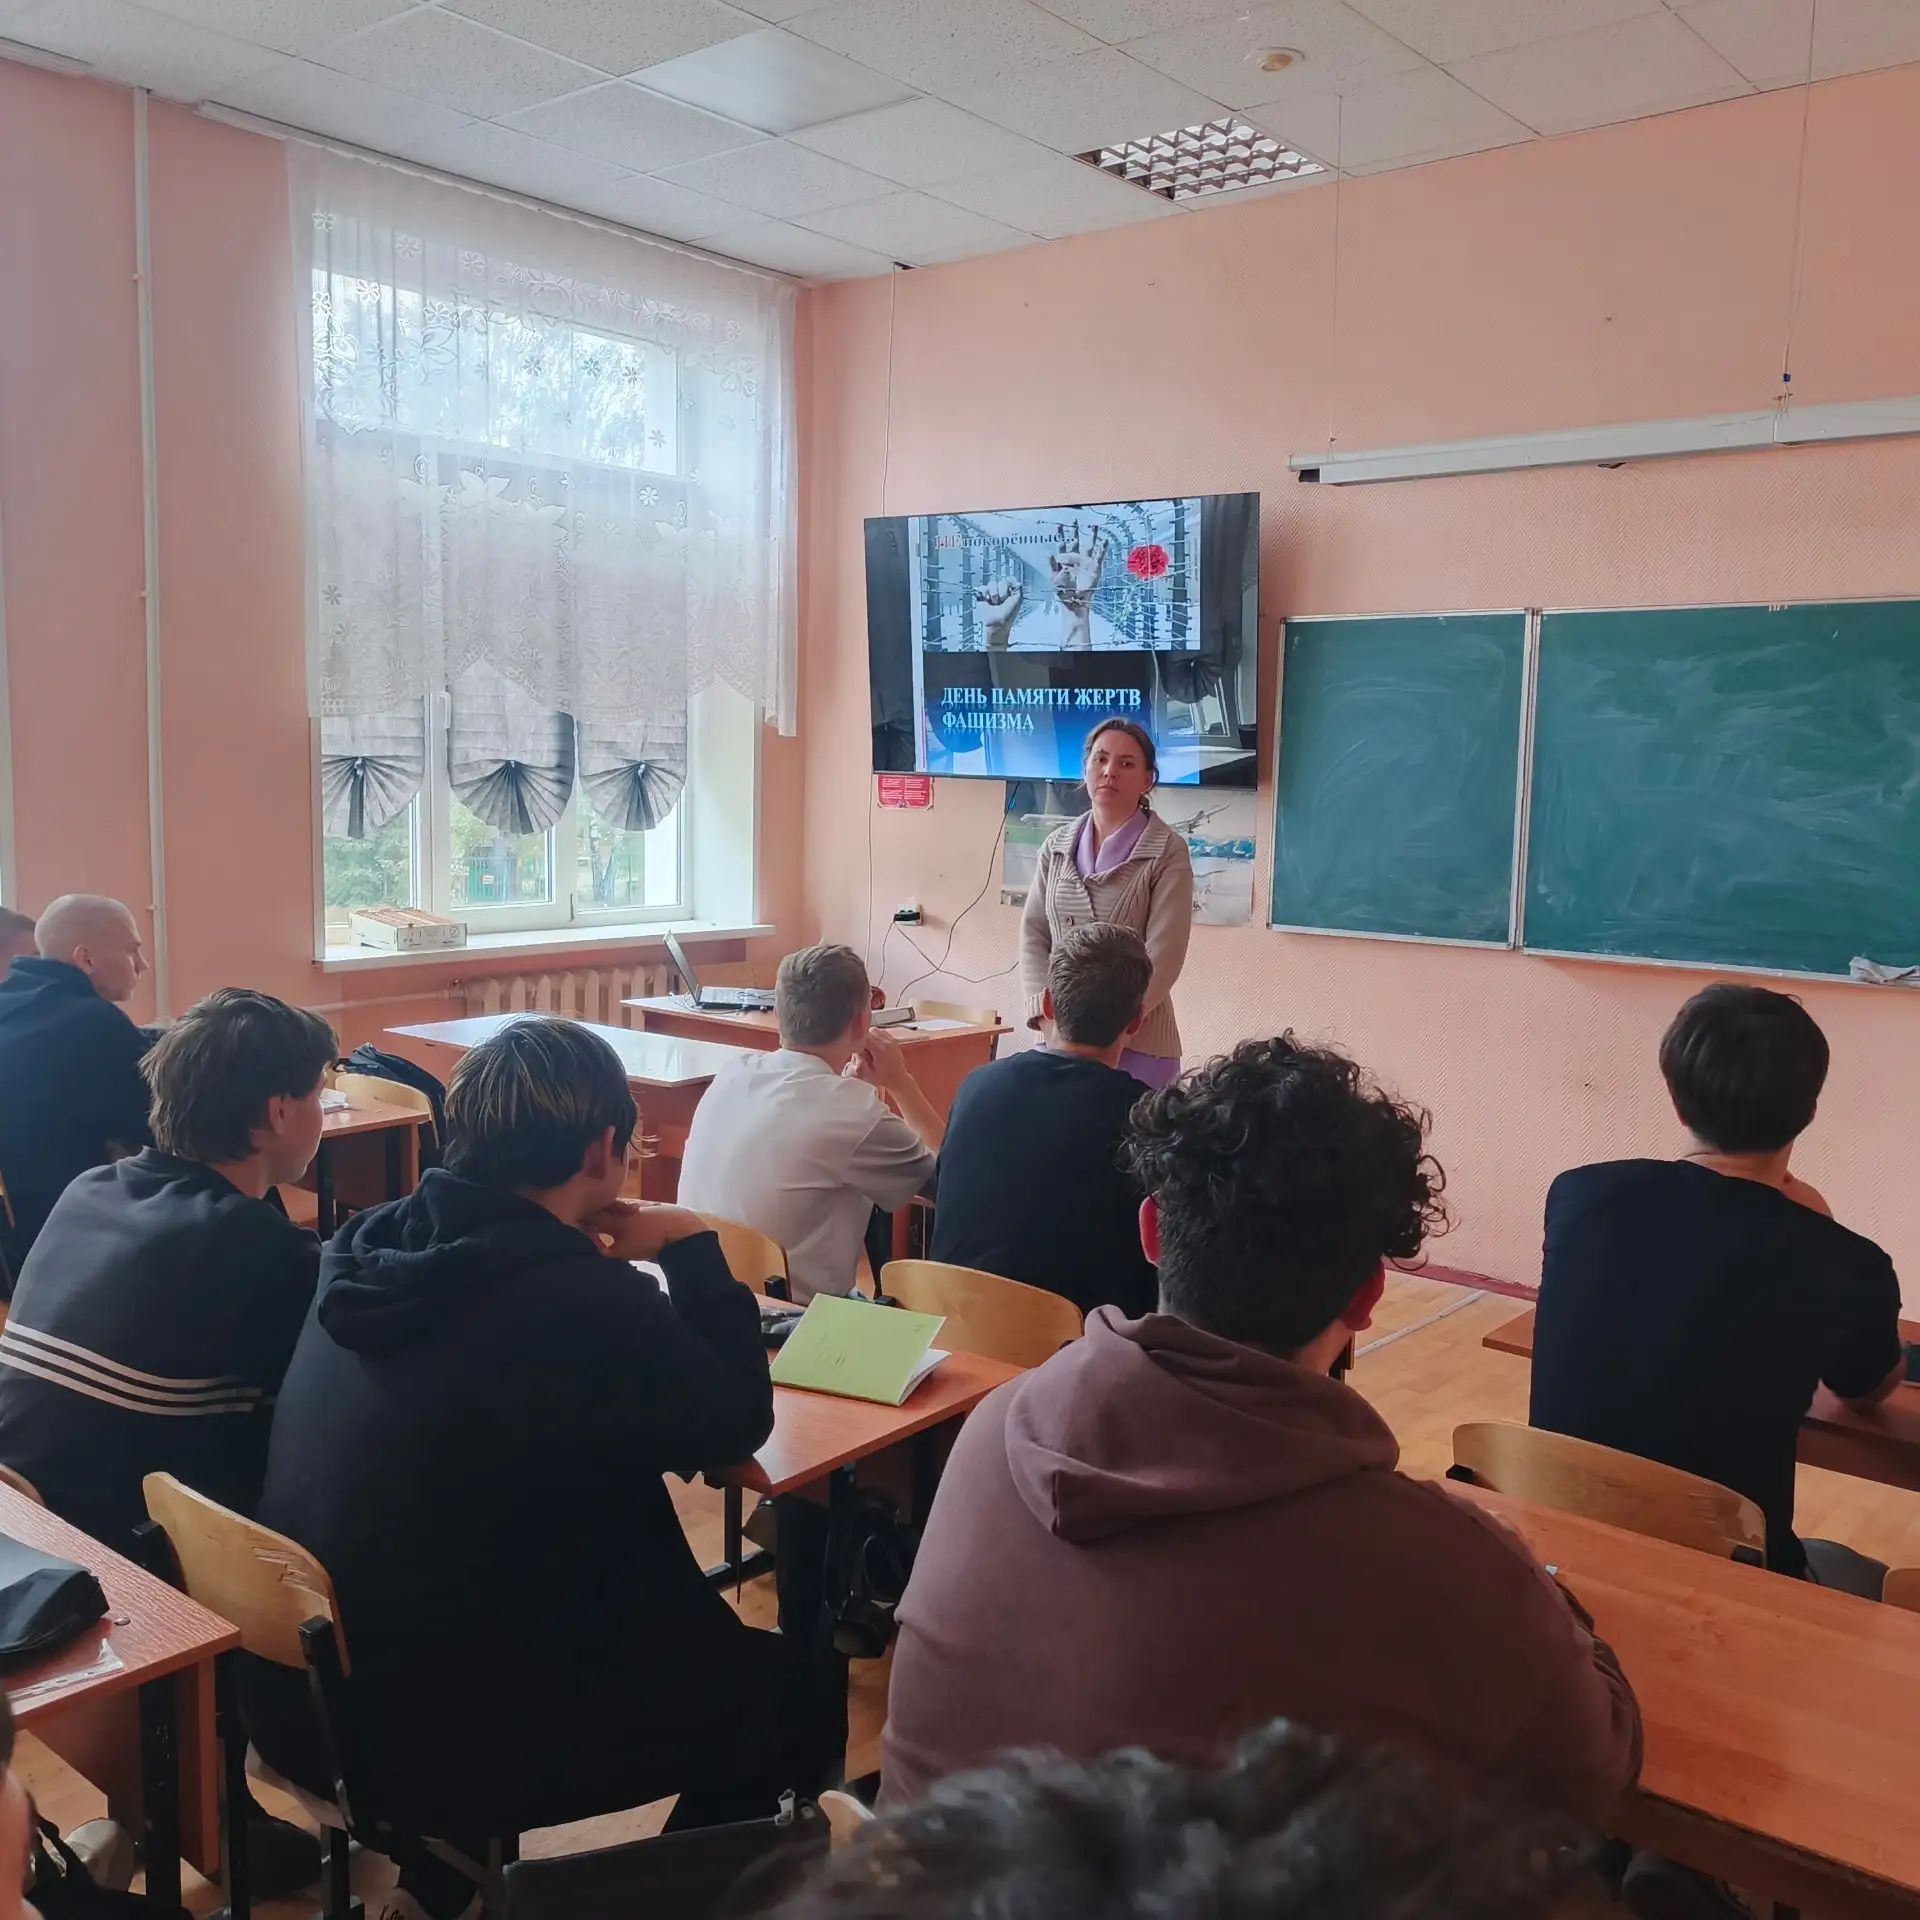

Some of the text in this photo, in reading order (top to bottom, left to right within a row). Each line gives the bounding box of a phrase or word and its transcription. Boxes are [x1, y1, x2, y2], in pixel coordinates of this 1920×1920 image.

[941, 688, 1141, 706] ДЕНЬ ПАМЯТИ ЖЕРТВ
[942, 712, 1035, 729] ФАШИЗМА
